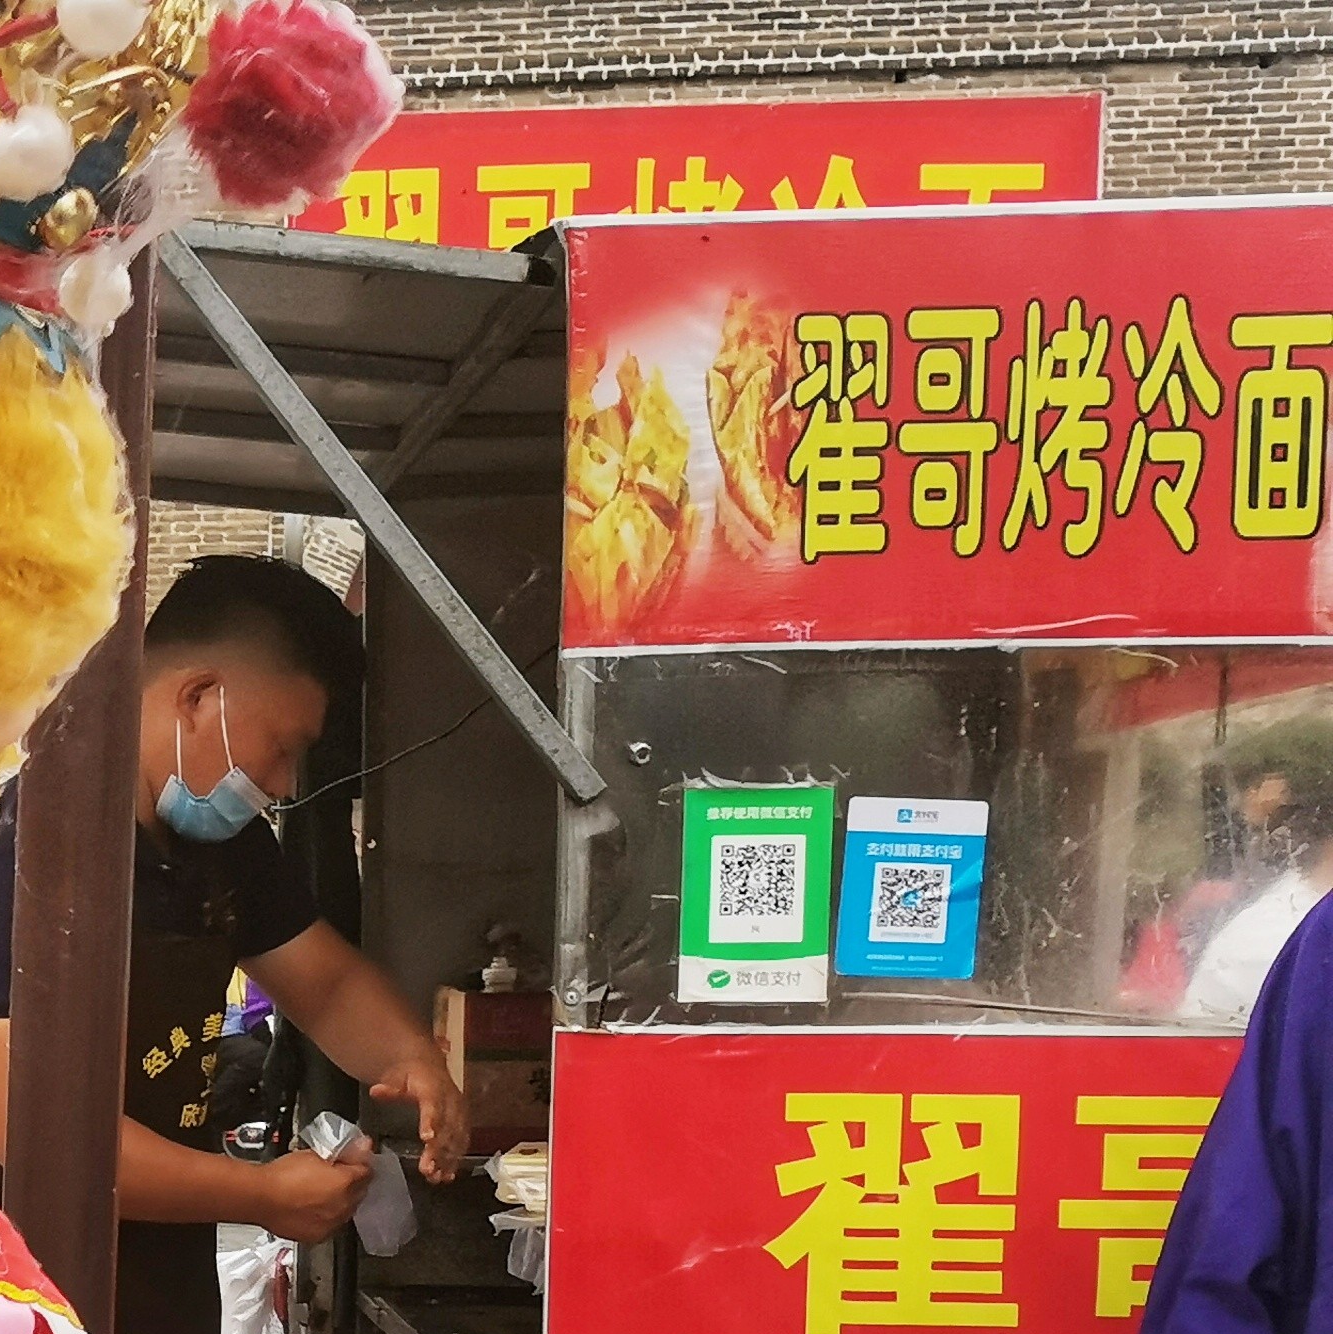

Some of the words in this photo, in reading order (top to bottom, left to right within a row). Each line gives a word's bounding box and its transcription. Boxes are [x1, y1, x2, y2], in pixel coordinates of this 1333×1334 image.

[786, 294, 1333, 564] 翟哥烤冷面
[736, 971, 801, 986] 微信支付
